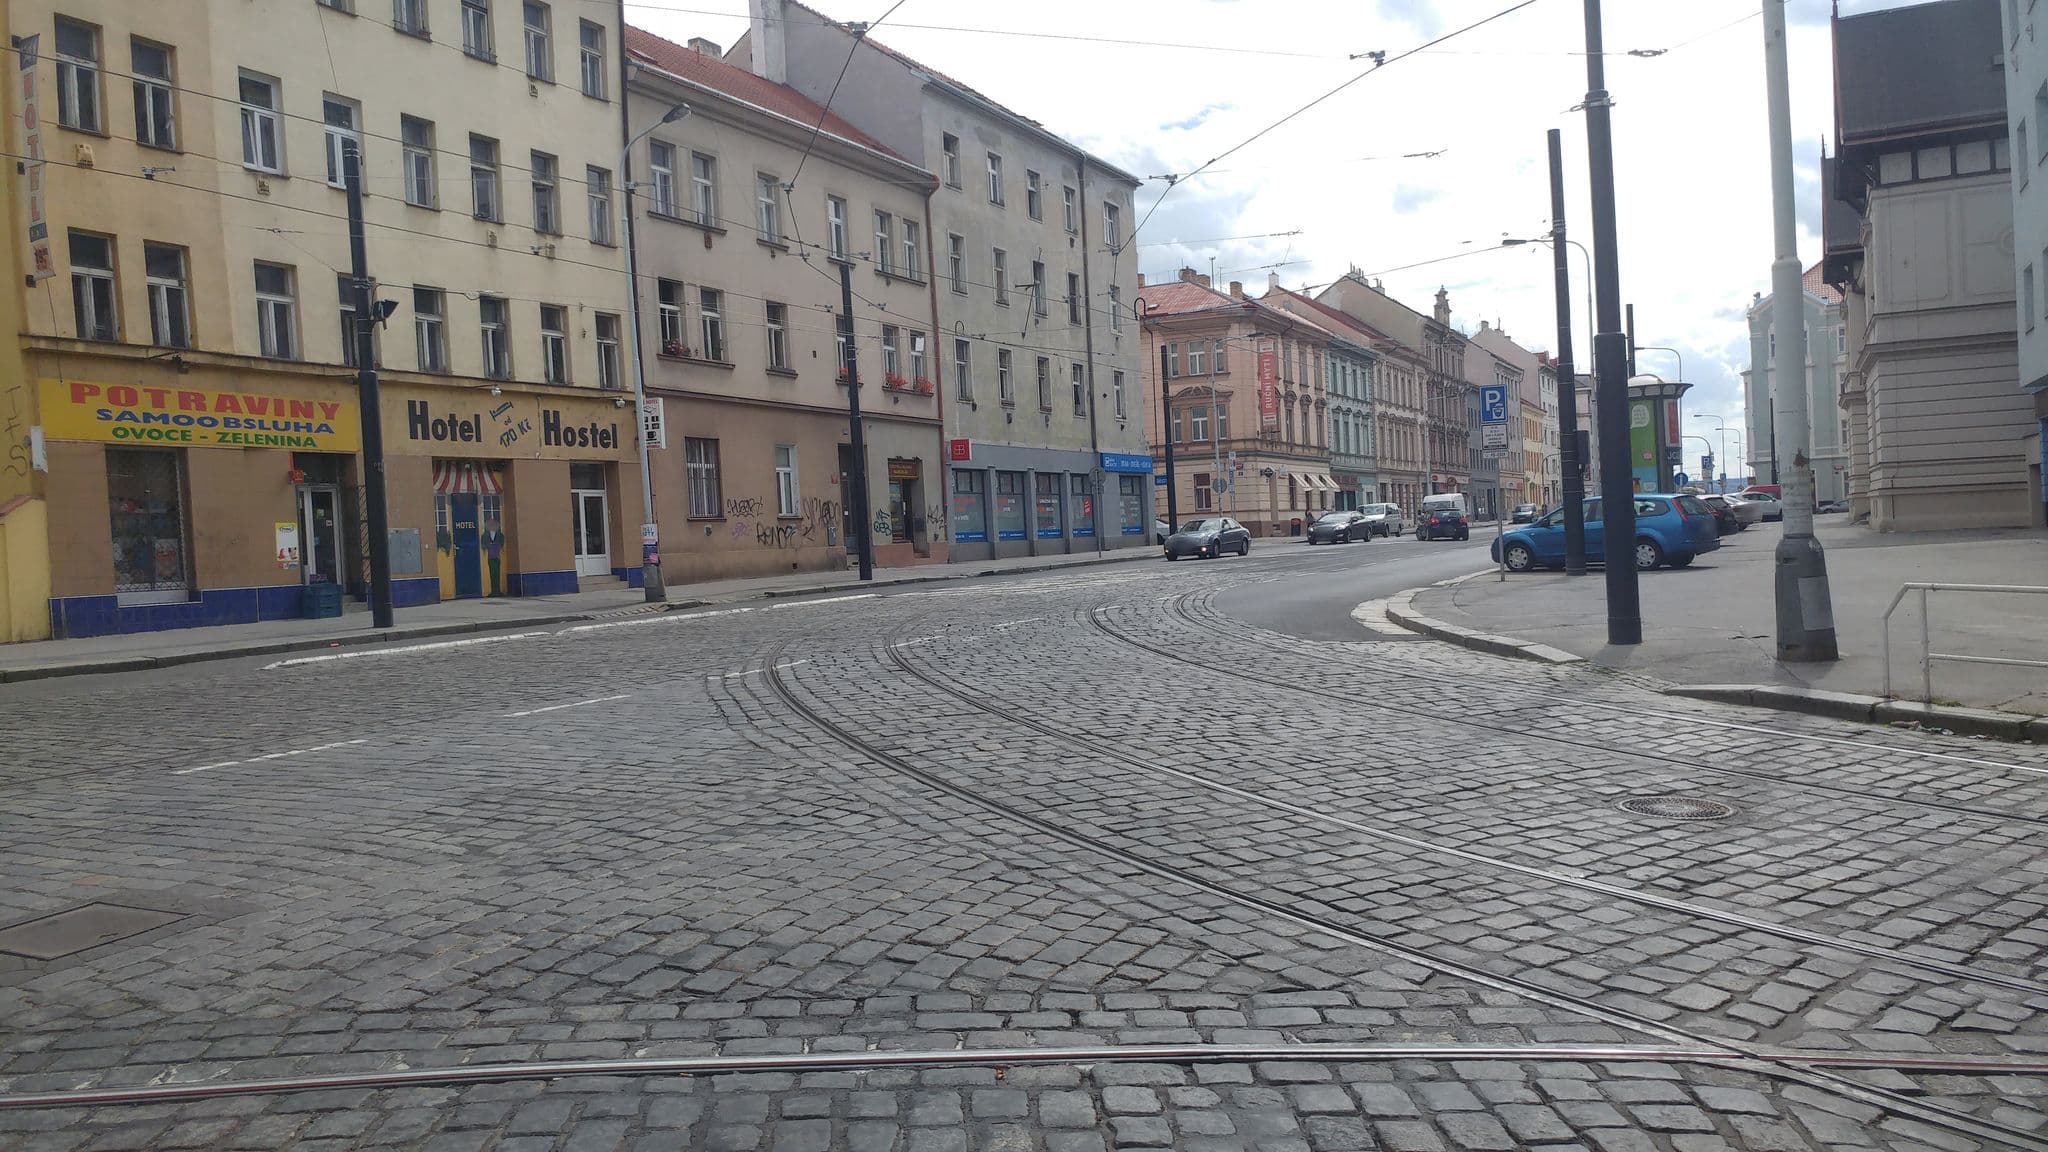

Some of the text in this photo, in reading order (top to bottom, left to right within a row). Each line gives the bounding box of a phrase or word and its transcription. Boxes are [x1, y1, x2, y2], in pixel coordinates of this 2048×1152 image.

[70, 382, 341, 421] POTRAVINY
[1485, 389, 1501, 412] P
[95, 408, 336, 434] SAMOOBSLUHA
[407, 399, 482, 443] Hotel
[543, 409, 619, 449] Hostel
[111, 426, 193, 442] OVOCE
[215, 431, 318, 448] ZELENINA
[499, 428, 518, 449] 170
[455, 521, 476, 529] HOTEL
